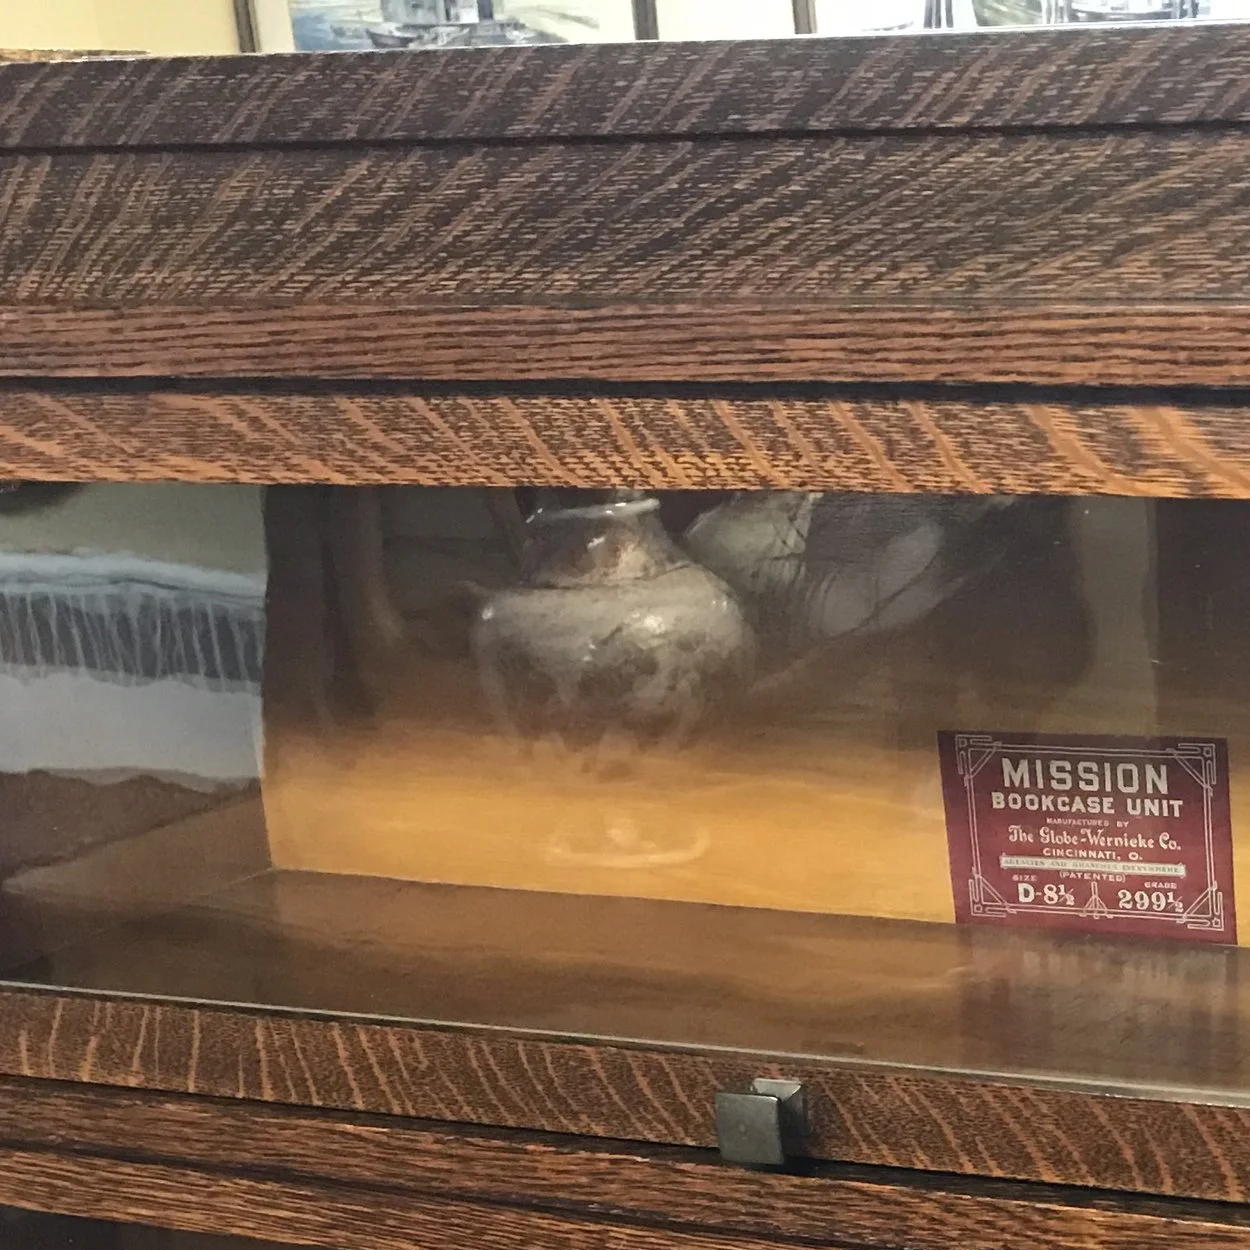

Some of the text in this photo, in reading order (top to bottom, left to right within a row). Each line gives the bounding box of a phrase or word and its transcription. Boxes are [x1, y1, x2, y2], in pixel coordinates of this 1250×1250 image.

[1002, 758, 1169, 794] MISSION
[992, 792, 1183, 817] BOOKCASE UNIT
[1008, 825, 1034, 843] The
[1159, 832, 1181, 850] Co.
[1012, 874, 1037, 882] SIZE
[1059, 871, 1126, 883] (PATENTED)
